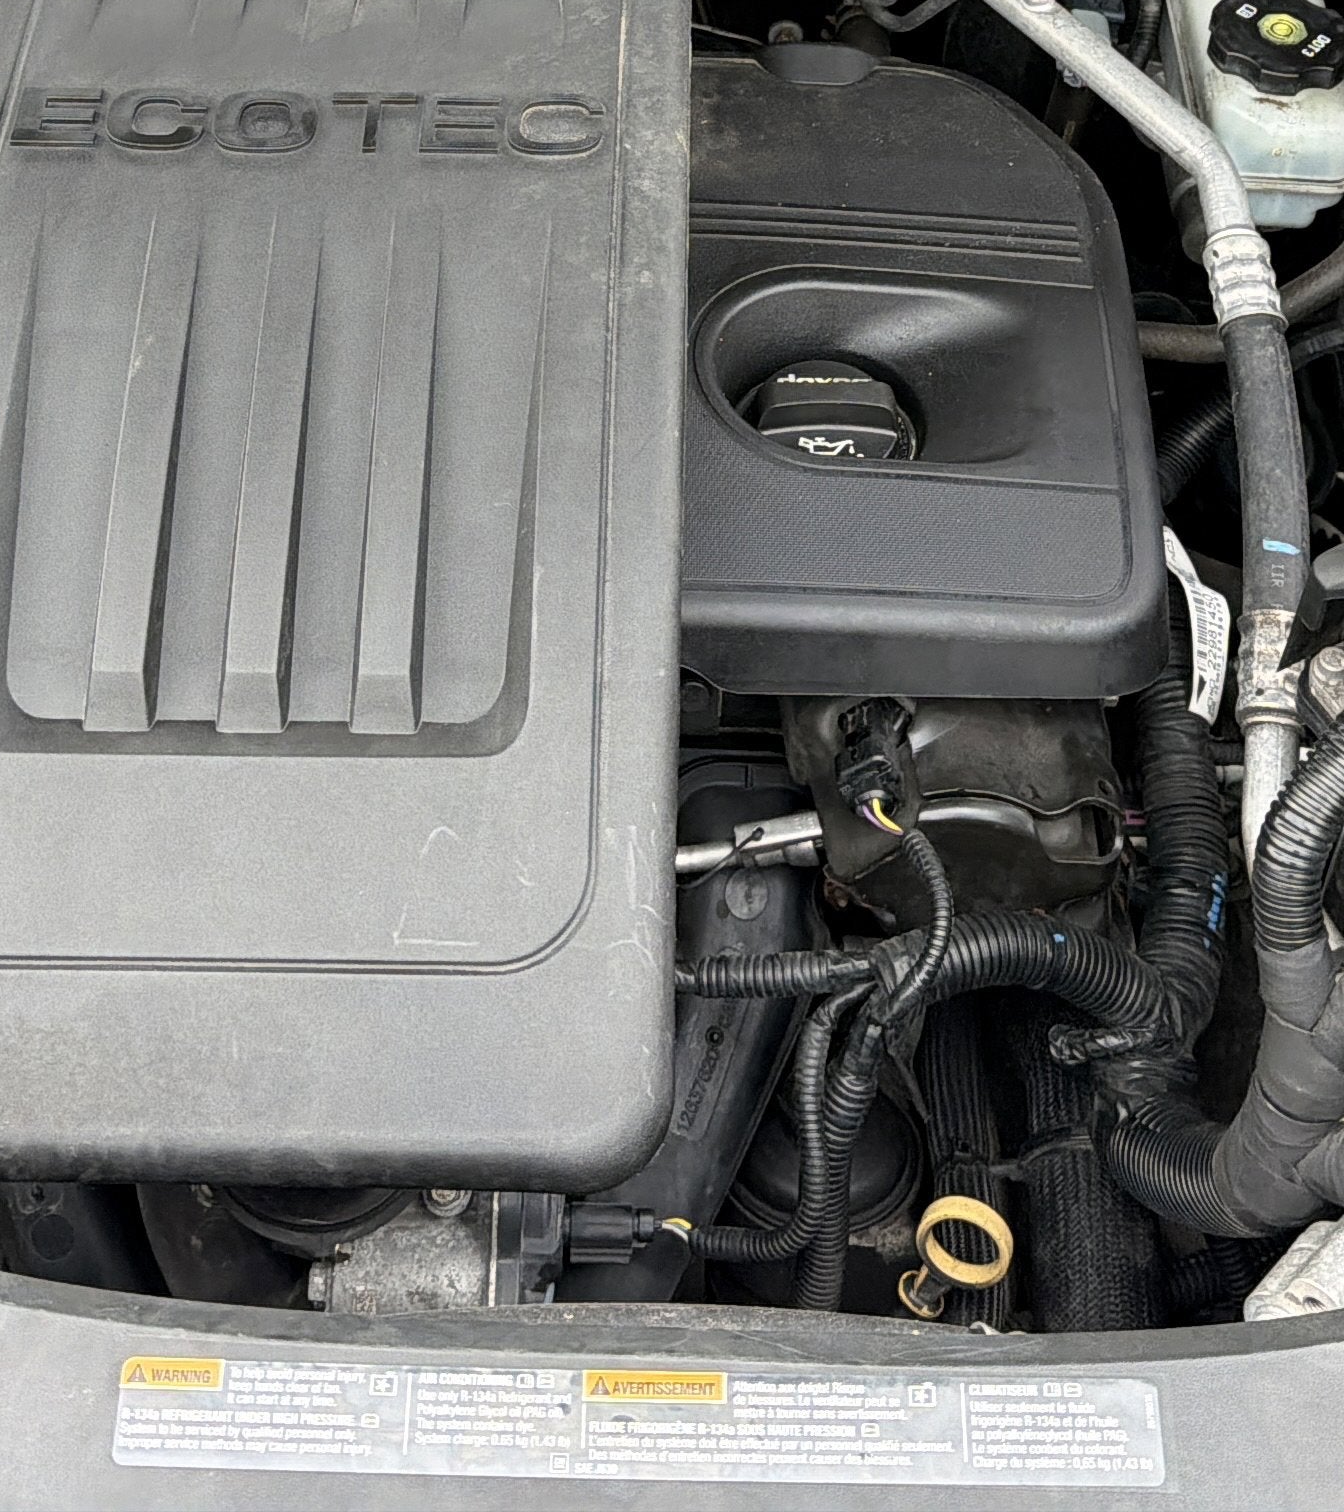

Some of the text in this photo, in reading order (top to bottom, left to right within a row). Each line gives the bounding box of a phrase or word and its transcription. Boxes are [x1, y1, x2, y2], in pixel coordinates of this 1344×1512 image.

[9, 86, 606, 157] ECOTEC
[151, 1368, 212, 1384] WARNING
[231, 1367, 365, 1383] To help avoid personal injury.
[419, 1373, 513, 1386] AIR CONDITIONING
[229, 1381, 252, 1393] keep
[255, 1382, 283, 1392] hands
[286, 1382, 309, 1393] clear
[311, 1383, 321, 1393] of
[612, 1380, 715, 1397] AVERTISSEMENT
[733, 1381, 776, 1393] Attention
[779, 1384, 795, 1393] aux
[833, 1383, 866, 1396] Risque
[969, 1384, 1038, 1396] CLIMATISEUR
[227, 1395, 336, 1408] It can start at any time.
[417, 1390, 571, 1405] Use only R-134a Refrigerant and
[733, 1395, 901, 1408] de blessures. Le ventilateur peut se
[417, 1404, 476, 1416] Polyalkylene
[479, 1405, 507, 1418] Glycol
[509, 1406, 522, 1417] oil
[524, 1407, 547, 1418] (PAG
[734, 1407, 908, 1421] mettre à tourner sans avertissement.
[970, 1401, 1096, 1413] Utiliser seulement le fluide
[162, 1410, 232, 1422] REFRIGERANT
[235, 1412, 270, 1423] UNDER
[273, 1413, 298, 1423] HIGH
[1025, 1416, 1060, 1427] R-134a
[1063, 1416, 1072, 1426] et
[1074, 1417, 1087, 1427] de
[120, 1424, 356, 1441] System to be serviced by qualified personnel only.
[416, 1418, 536, 1433] The system contains dye.
[589, 1421, 625, 1433] FLUIDE
[698, 1423, 735, 1435] R-134a
[737, 1424, 765, 1436] SOUS
[768, 1424, 801, 1436] HAUTE
[804, 1425, 856, 1437] PRESSION
[415, 1432, 451, 1445] System
[516, 1435, 528, 1448] kg
[971, 1431, 984, 1440] au
[1075, 1431, 1101, 1441] (huile
[119, 1436, 372, 1456] Improper service methods may cause personal injury.
[641, 1438, 654, 1448] du
[656, 1438, 696, 1450] système
[699, 1438, 717, 1449] doit
[719, 1438, 739, 1449] être
[741, 1438, 780, 1450] effectué
[782, 1441, 797, 1451] par
[801, 1441, 812, 1450] un
[815, 1440, 862, 1452] personnel
[902, 1440, 955, 1452] seulement.
[972, 1443, 1127, 1456] Le système contient du colorant.
[589, 1449, 607, 1461] Des
[610, 1450, 657, 1462] méthodes
[714, 1451, 767, 1464] incorrectes
[809, 1455, 842, 1464] causer
[844, 1455, 862, 1465] des
[973, 1457, 1007, 1470] Charge
[1010, 1457, 1023, 1467] du
[1025, 1457, 1065, 1470] système
[1098, 1458, 1110, 1471] kg
